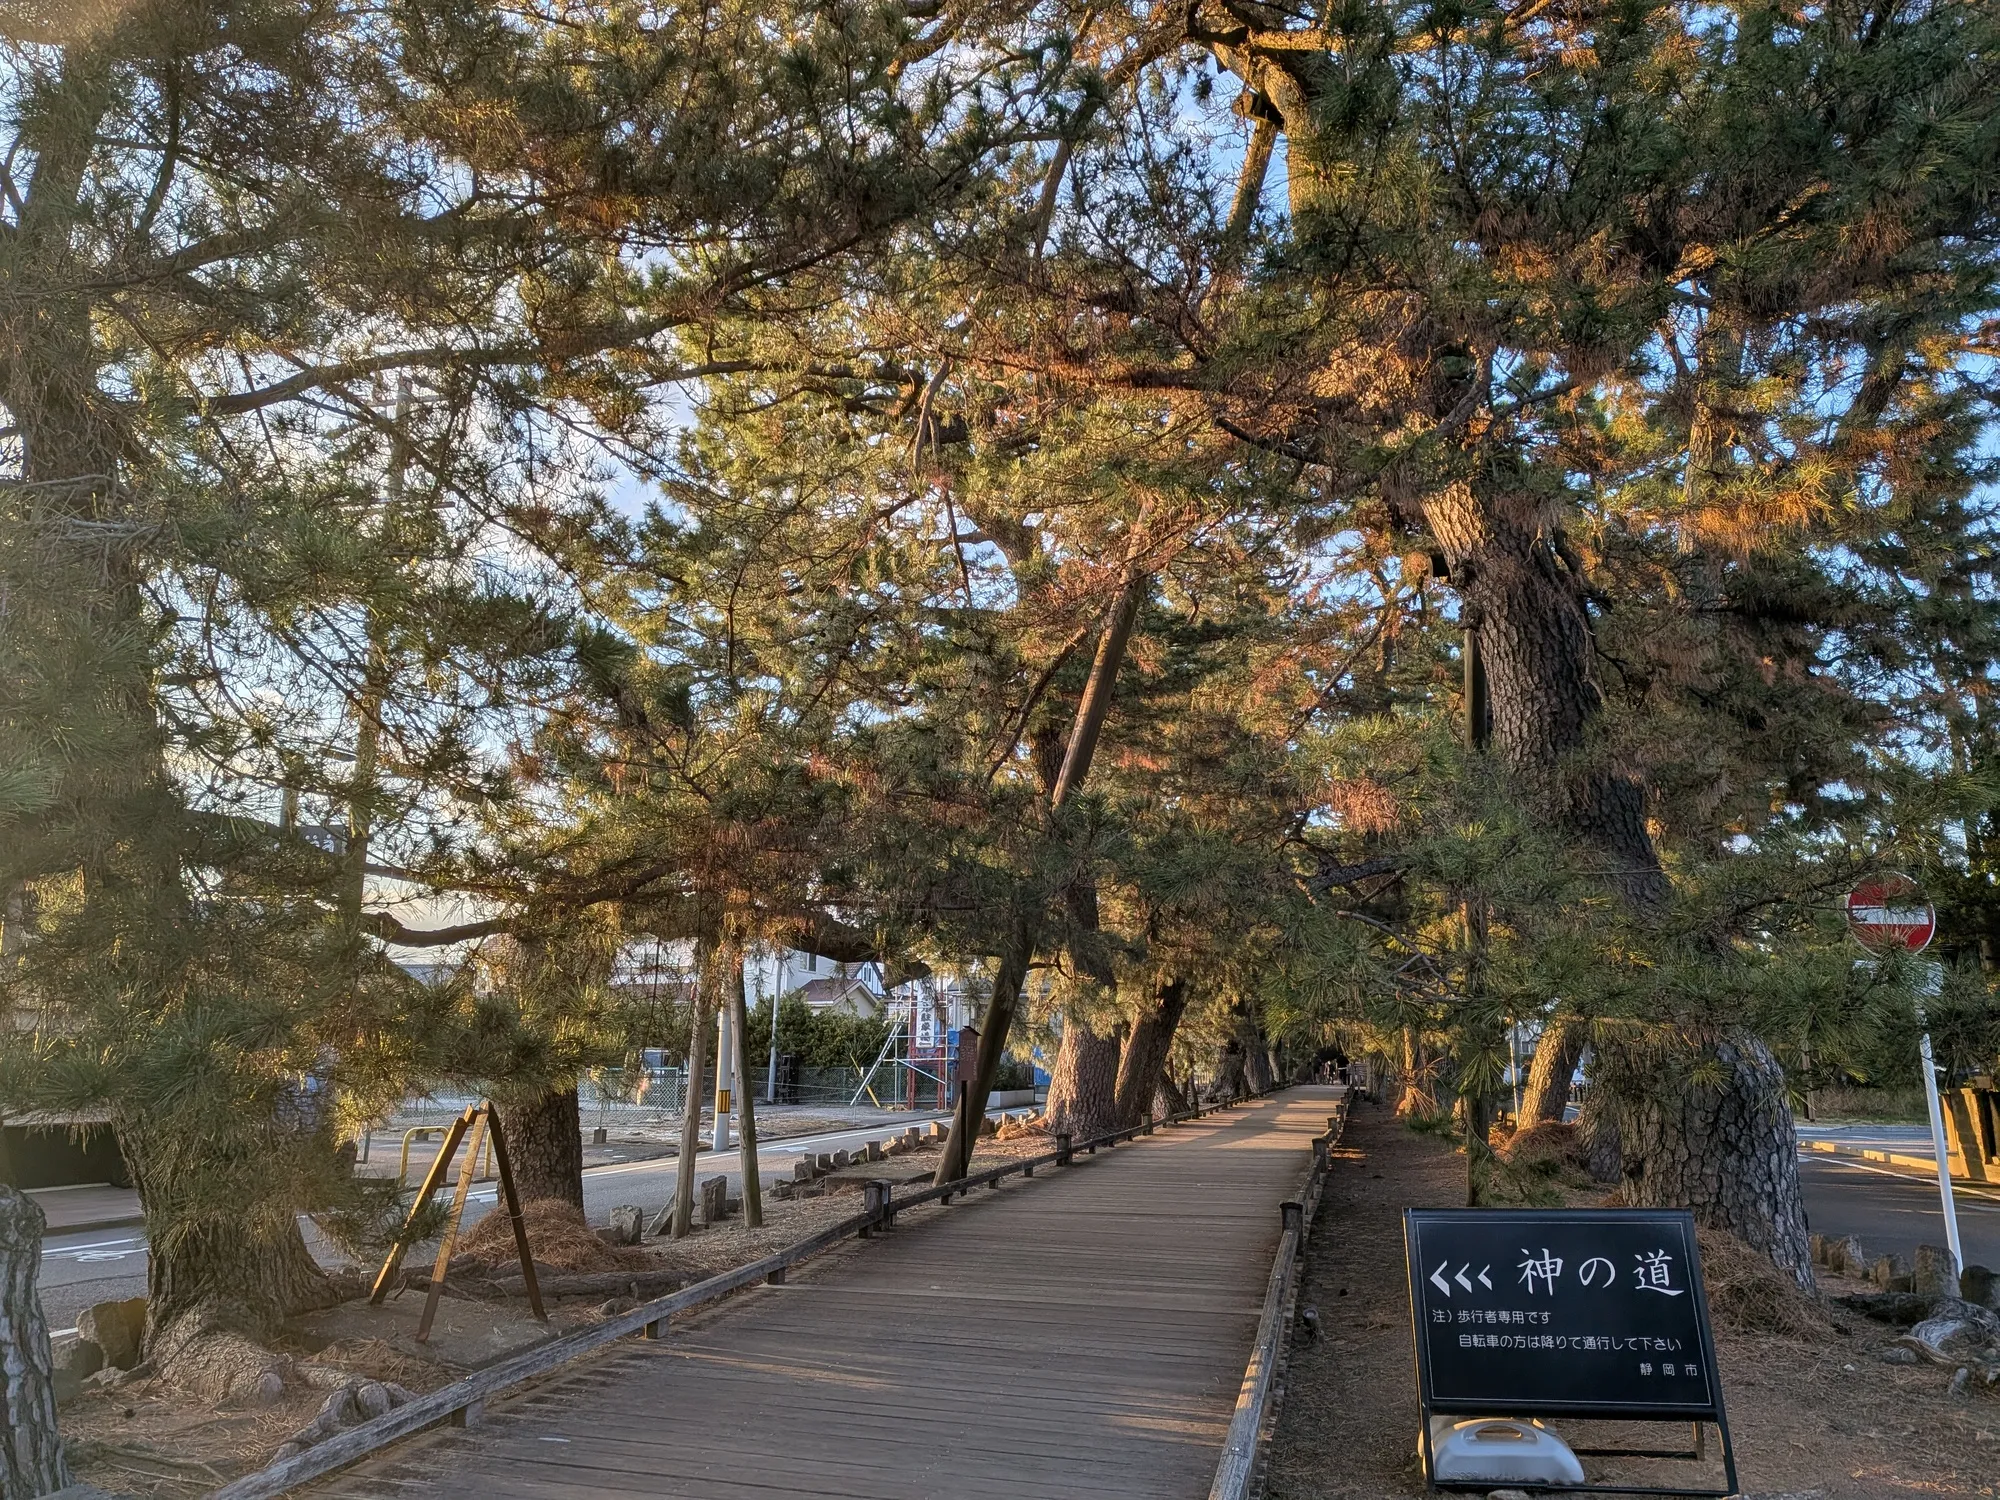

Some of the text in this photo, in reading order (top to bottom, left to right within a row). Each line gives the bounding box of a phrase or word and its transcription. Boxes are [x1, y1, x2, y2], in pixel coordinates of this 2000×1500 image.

[1516, 1247, 1685, 1297] 神の道
[1458, 1333, 1682, 1352] 自転車の方は降りて通行して下さい
[1639, 1362, 1698, 1377] 静岡市
